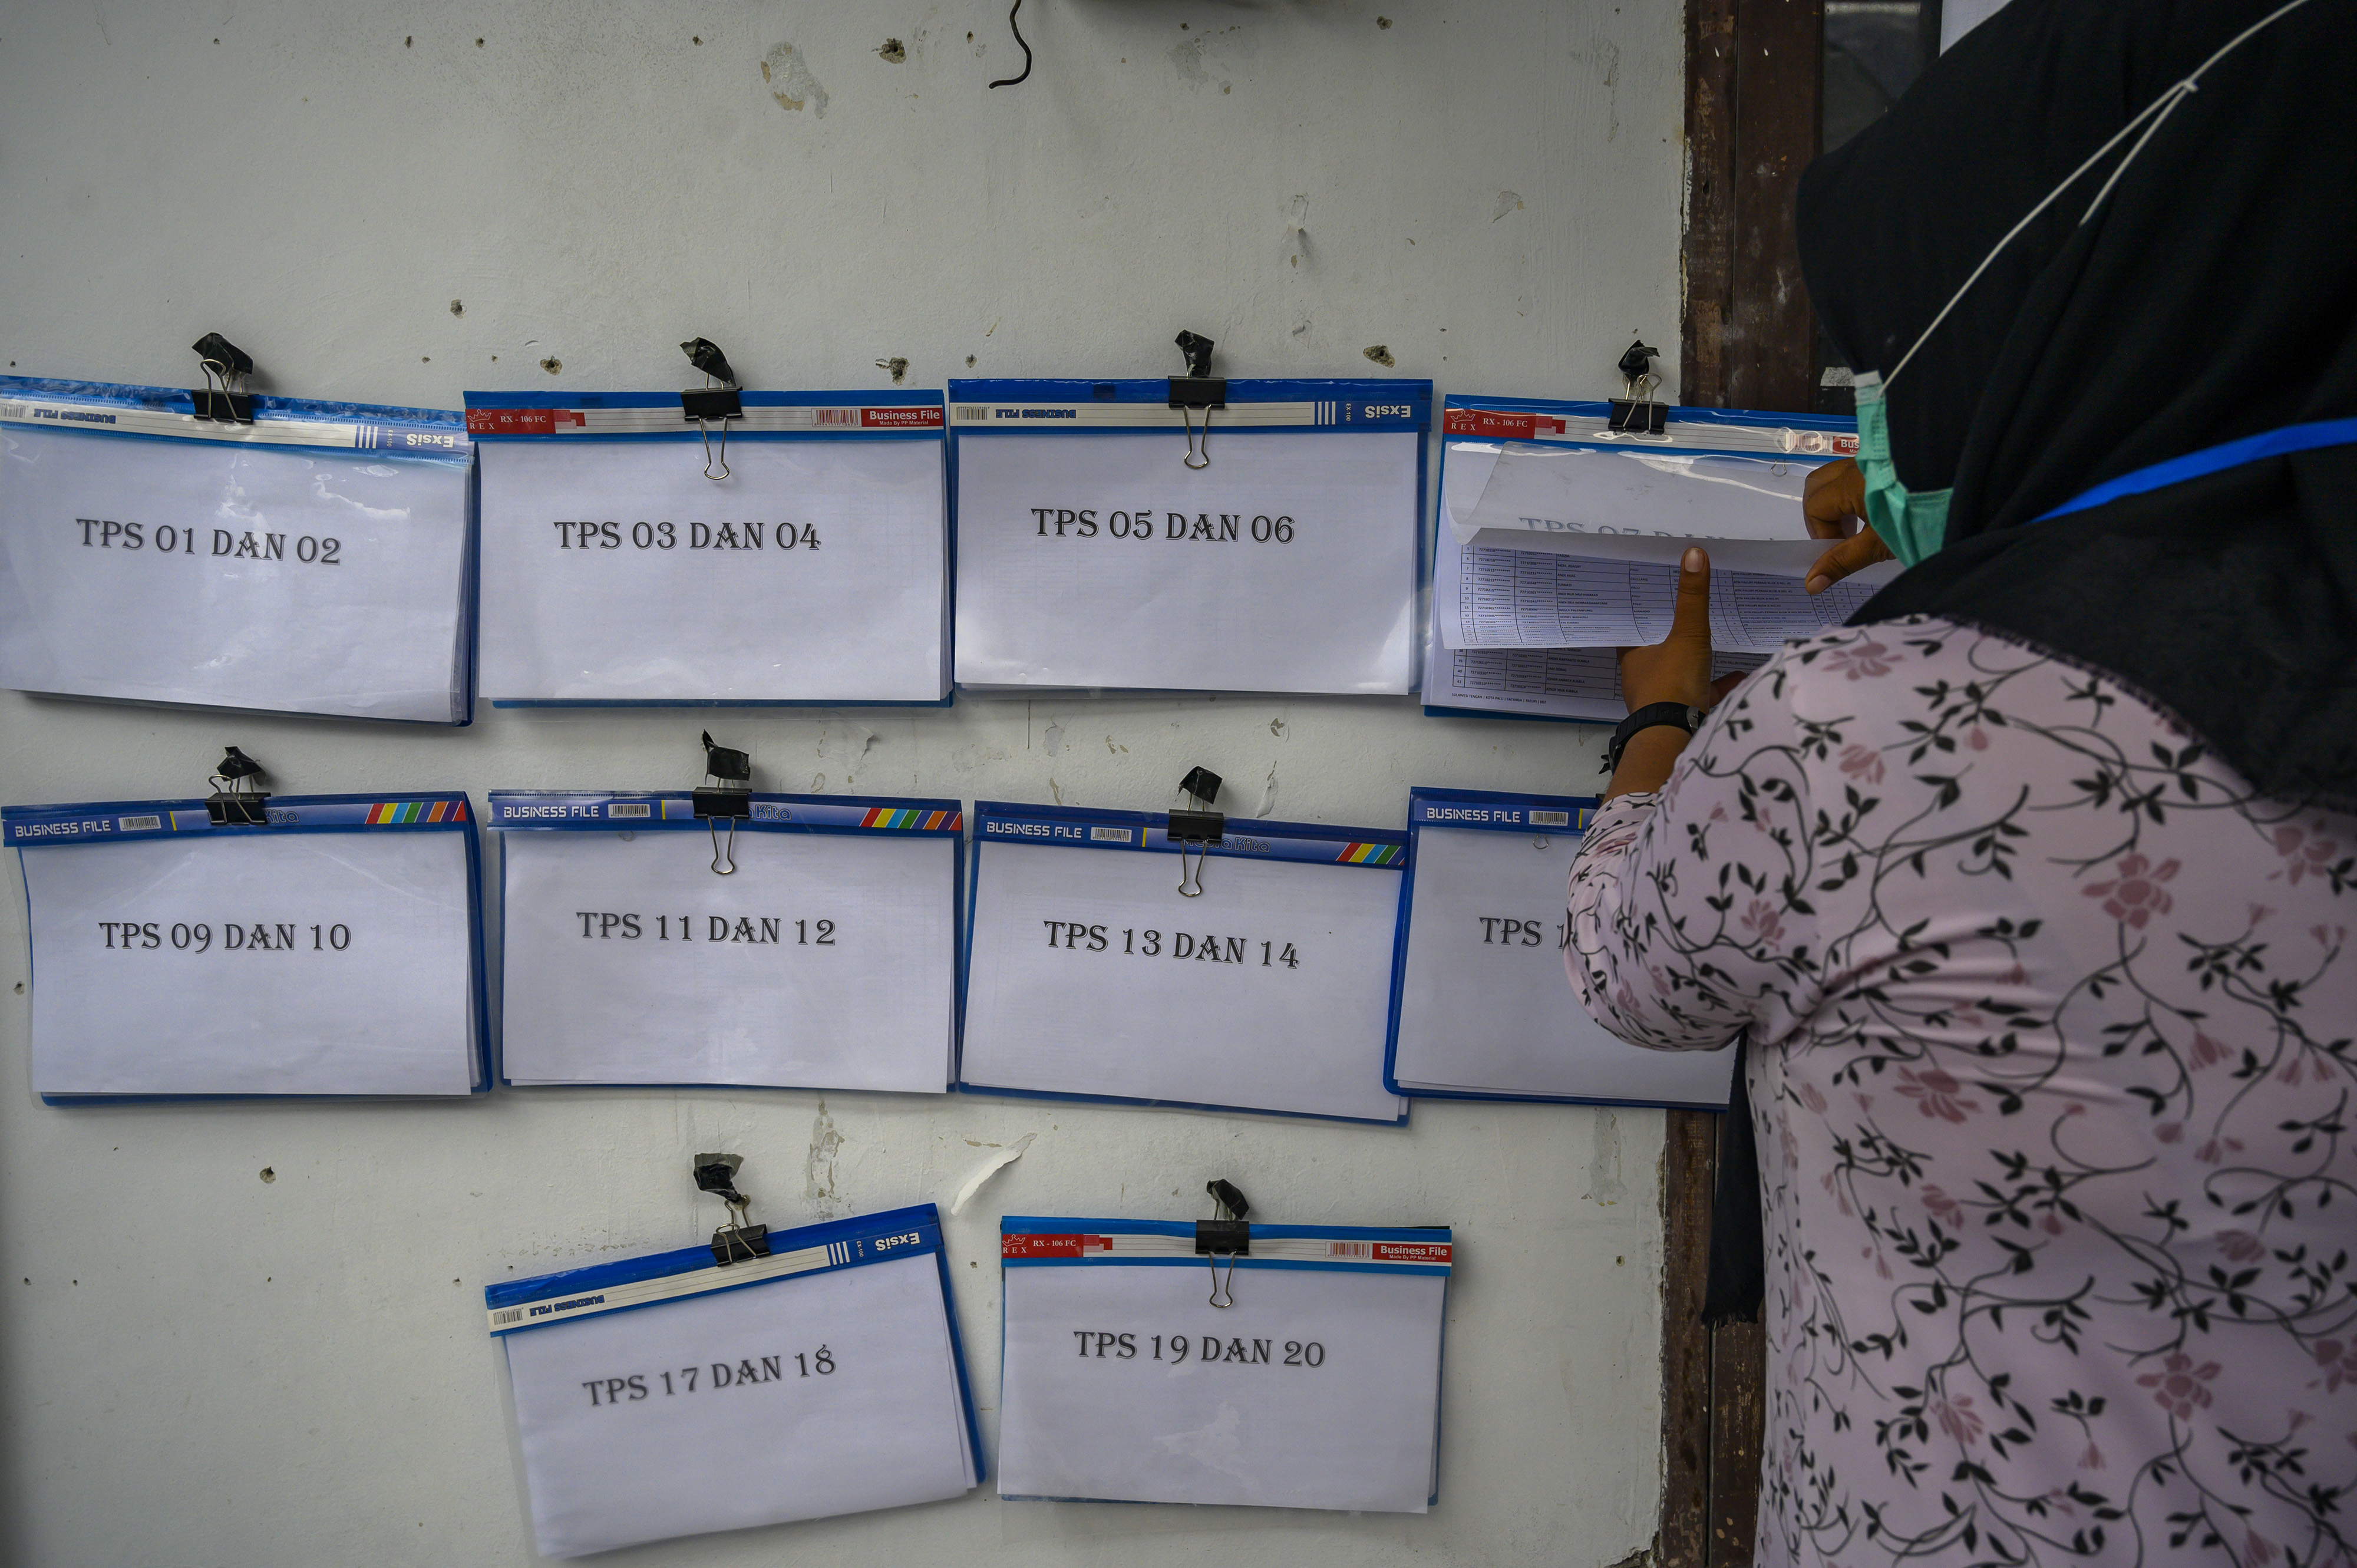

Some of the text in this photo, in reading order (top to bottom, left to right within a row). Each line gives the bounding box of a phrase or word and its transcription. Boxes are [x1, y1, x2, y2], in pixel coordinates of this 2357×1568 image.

[34, 408, 116, 424] BUSINESS FILE
[500, 415, 513, 424] RX
[870, 410, 940, 420] Business File
[996, 409, 1076, 418] BUSINESS FILE
[1031, 509, 1295, 544] TPS 05 DAN 06
[75, 518, 341, 565] TPS 01 DAN 02
[553, 522, 821, 550] TPS 03 DAN 04
[504, 806, 599, 818] BUSINESS FILE
[755, 804, 791, 820] Kita
[1427, 807, 1520, 823] BUSINESS FILE
[15, 822, 78, 837] BUSINESS
[83, 820, 111, 833] FILE
[987, 821, 1050, 836] BUSINESS
[1055, 826, 1082, 839] FILE
[1234, 837, 1270, 853] Kita
[576, 912, 836, 946] TPS 11 DAN 12
[1479, 917, 1565, 949] TPS 1
[98, 923, 351, 954] TPS 09 DAN 10
[1044, 920, 1300, 969] TPS 13 DAN 14
[1381, 1245, 1447, 1256] Business File
[529, 1304, 552, 1316] FILE
[554, 1295, 605, 1312] BUSINESS
[1073, 1331, 1326, 1368] TPS 19 DAN 20
[582, 1343, 836, 1407] TPS 17 DAN 18
